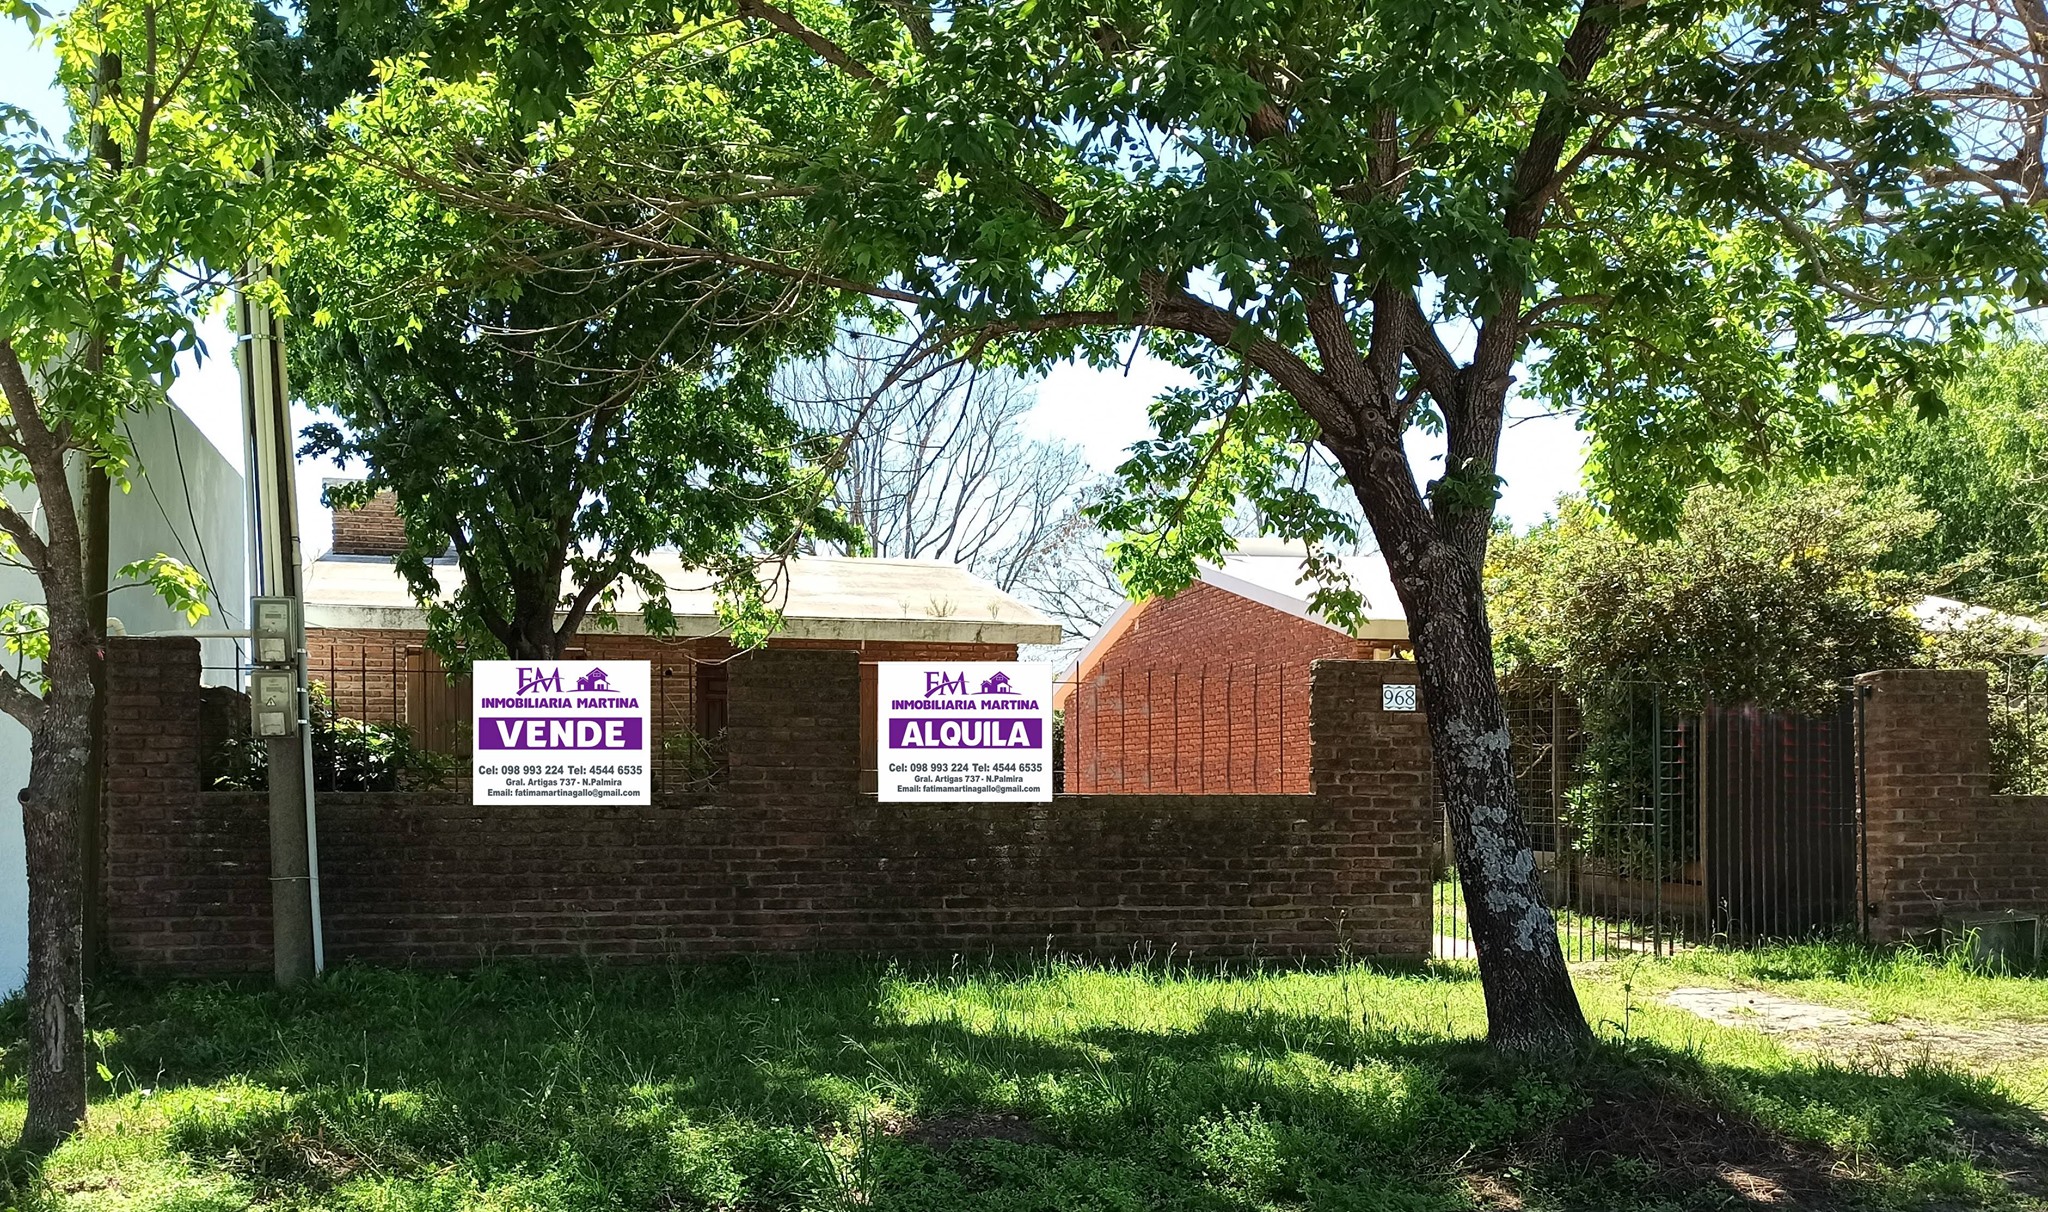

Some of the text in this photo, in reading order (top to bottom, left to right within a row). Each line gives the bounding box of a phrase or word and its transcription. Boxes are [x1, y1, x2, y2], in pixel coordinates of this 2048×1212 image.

[1384, 690, 1415, 706] 968
[482, 698, 639, 708] INMOBILIARIA MARTINA
[892, 700, 1039, 710] INMOBILIARIA MARTINA
[496, 720, 626, 747] VENDE
[901, 721, 1030, 746] ALQUILA
[479, 765, 642, 774] Cel: 098 993 224 Tel: 4544 6535
[889, 763, 1042, 772] Cel: 098 993 224 Tel: 4544 6535
[506, 778, 525, 786] Gral.
[528, 778, 557, 787] Artigas
[935, 775, 963, 784] Artigas
[515, 789, 640, 798] fatimamartinagallo@gmail.com
[923, 785, 1040, 794] fatimamartinagallo@gmail.com
